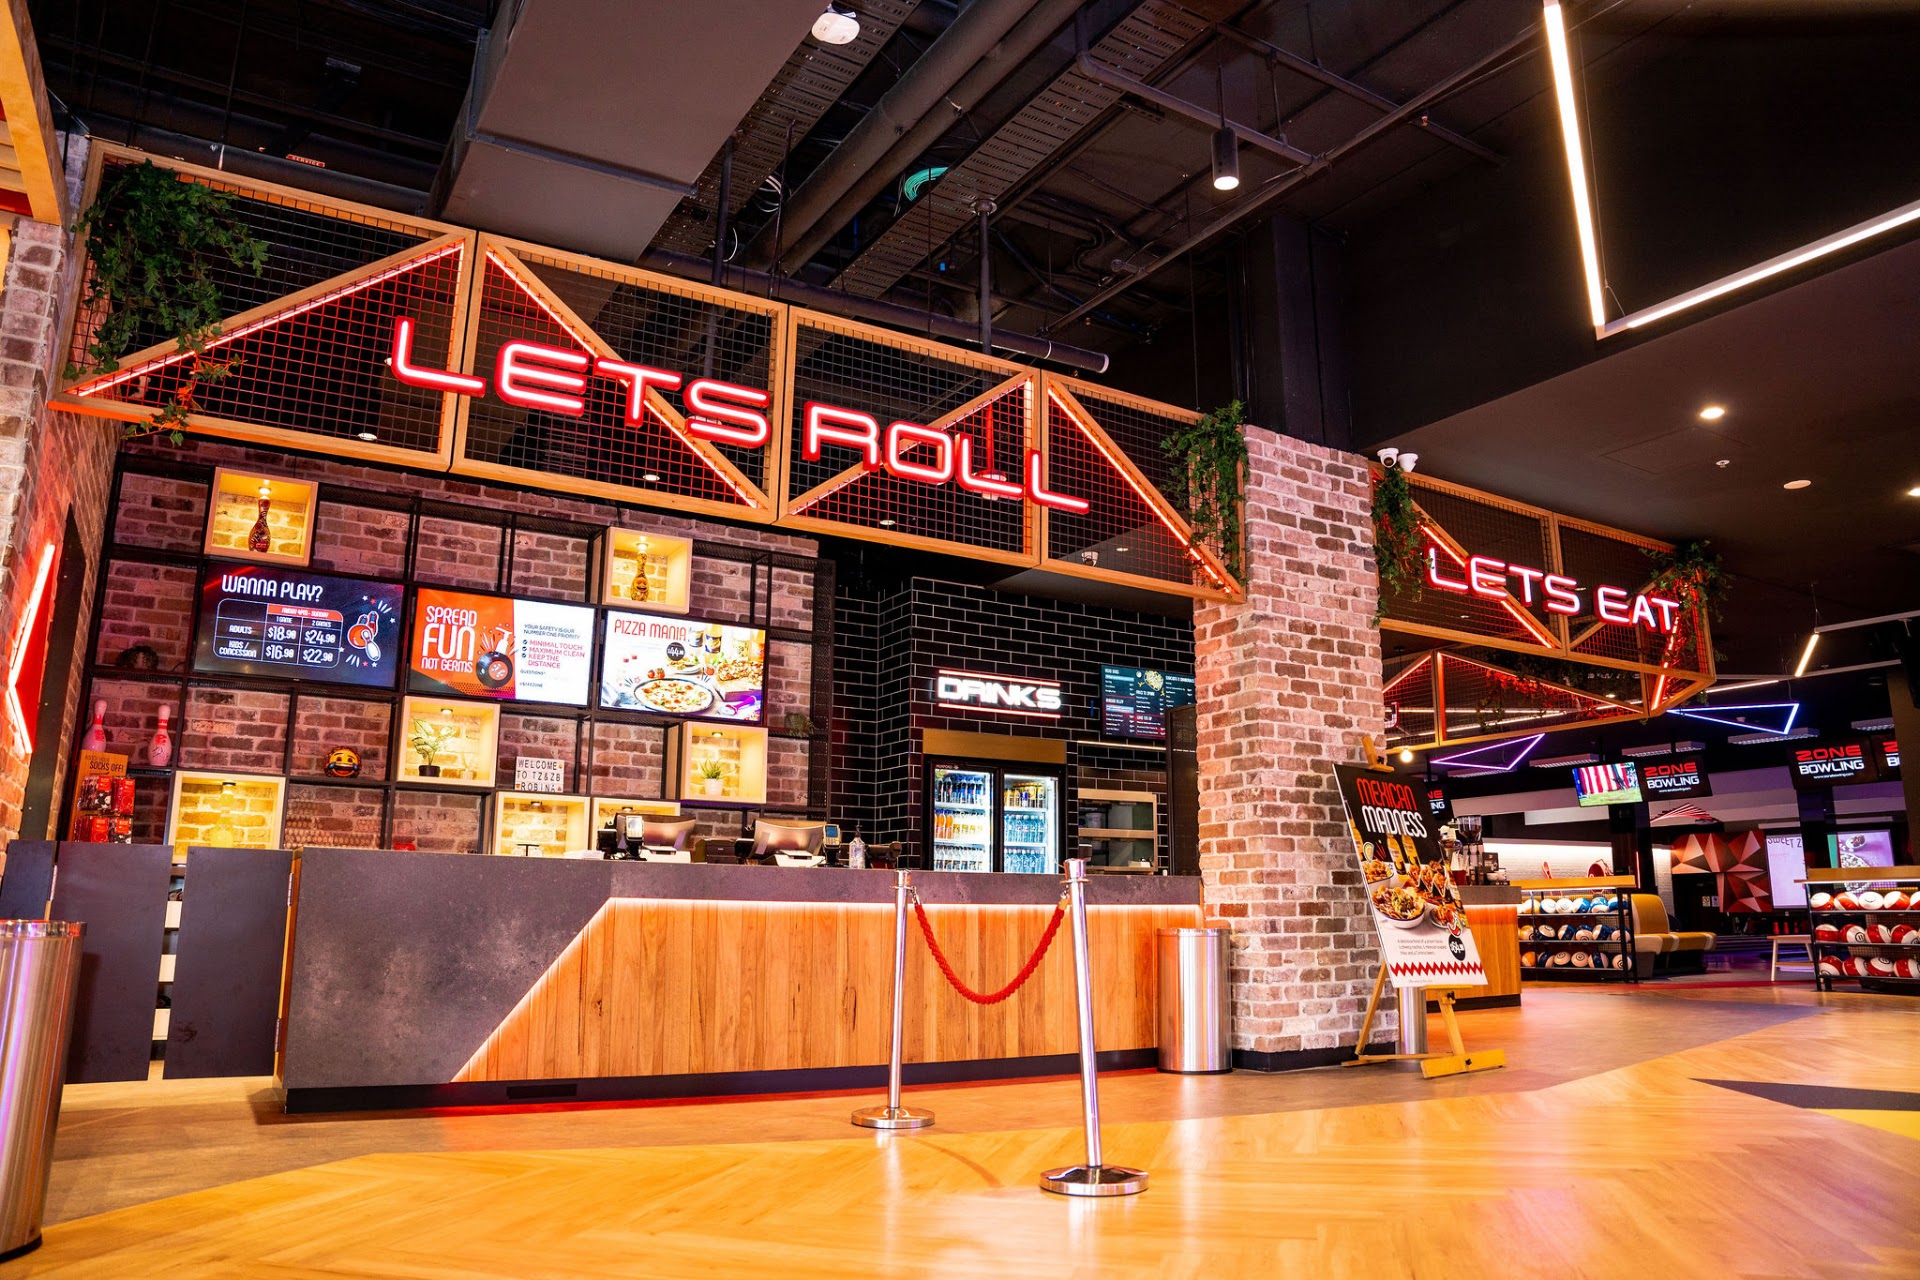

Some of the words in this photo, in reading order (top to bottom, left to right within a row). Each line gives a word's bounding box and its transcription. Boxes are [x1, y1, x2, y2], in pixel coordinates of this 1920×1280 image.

[391, 315, 771, 449] LETS
[802, 401, 1090, 515] ROLL
[221, 574, 277, 597] WANNA
[280, 581, 324, 602] PLAY?
[1424, 546, 1580, 616] LETS
[1594, 585, 1680, 634] EAT
[425, 605, 477, 628] SPREAD
[228, 624, 253, 635] ADULTS
[539, 624, 558, 632] SAFETY
[614, 618, 646, 636] PIZZA
[649, 622, 687, 641] MANIA
[422, 622, 475, 661] FUN
[529, 640, 558, 648] MINIMAL
[560, 642, 583, 651] TOUCH
[218, 646, 257, 659] CONCESSION
[528, 646, 563, 655] MAXIMUM
[563, 650, 586, 658] CLEAN
[547, 654, 560, 662] THE
[421, 657, 439, 671] NOT
[440, 658, 473, 674] GERMS
[527, 659, 561, 669] DISTANCE
[937, 676, 1062, 710] DRINKS
[1795, 744, 1862, 762] ZONE
[89, 761, 110, 772] SOCKS
[110, 764, 124, 773] OFF!
[518, 759, 557, 771] WELCOME
[1643, 761, 1698, 777] ZONE
[1798, 760, 1865, 775] BOWLING
[517, 770, 528, 779] TO
[1646, 775, 1700, 789] BOWLING
[520, 782, 556, 793] ROBINA
[1356, 777, 1418, 811] MEXICAN
[1361, 805, 1428, 839] MADNESS
